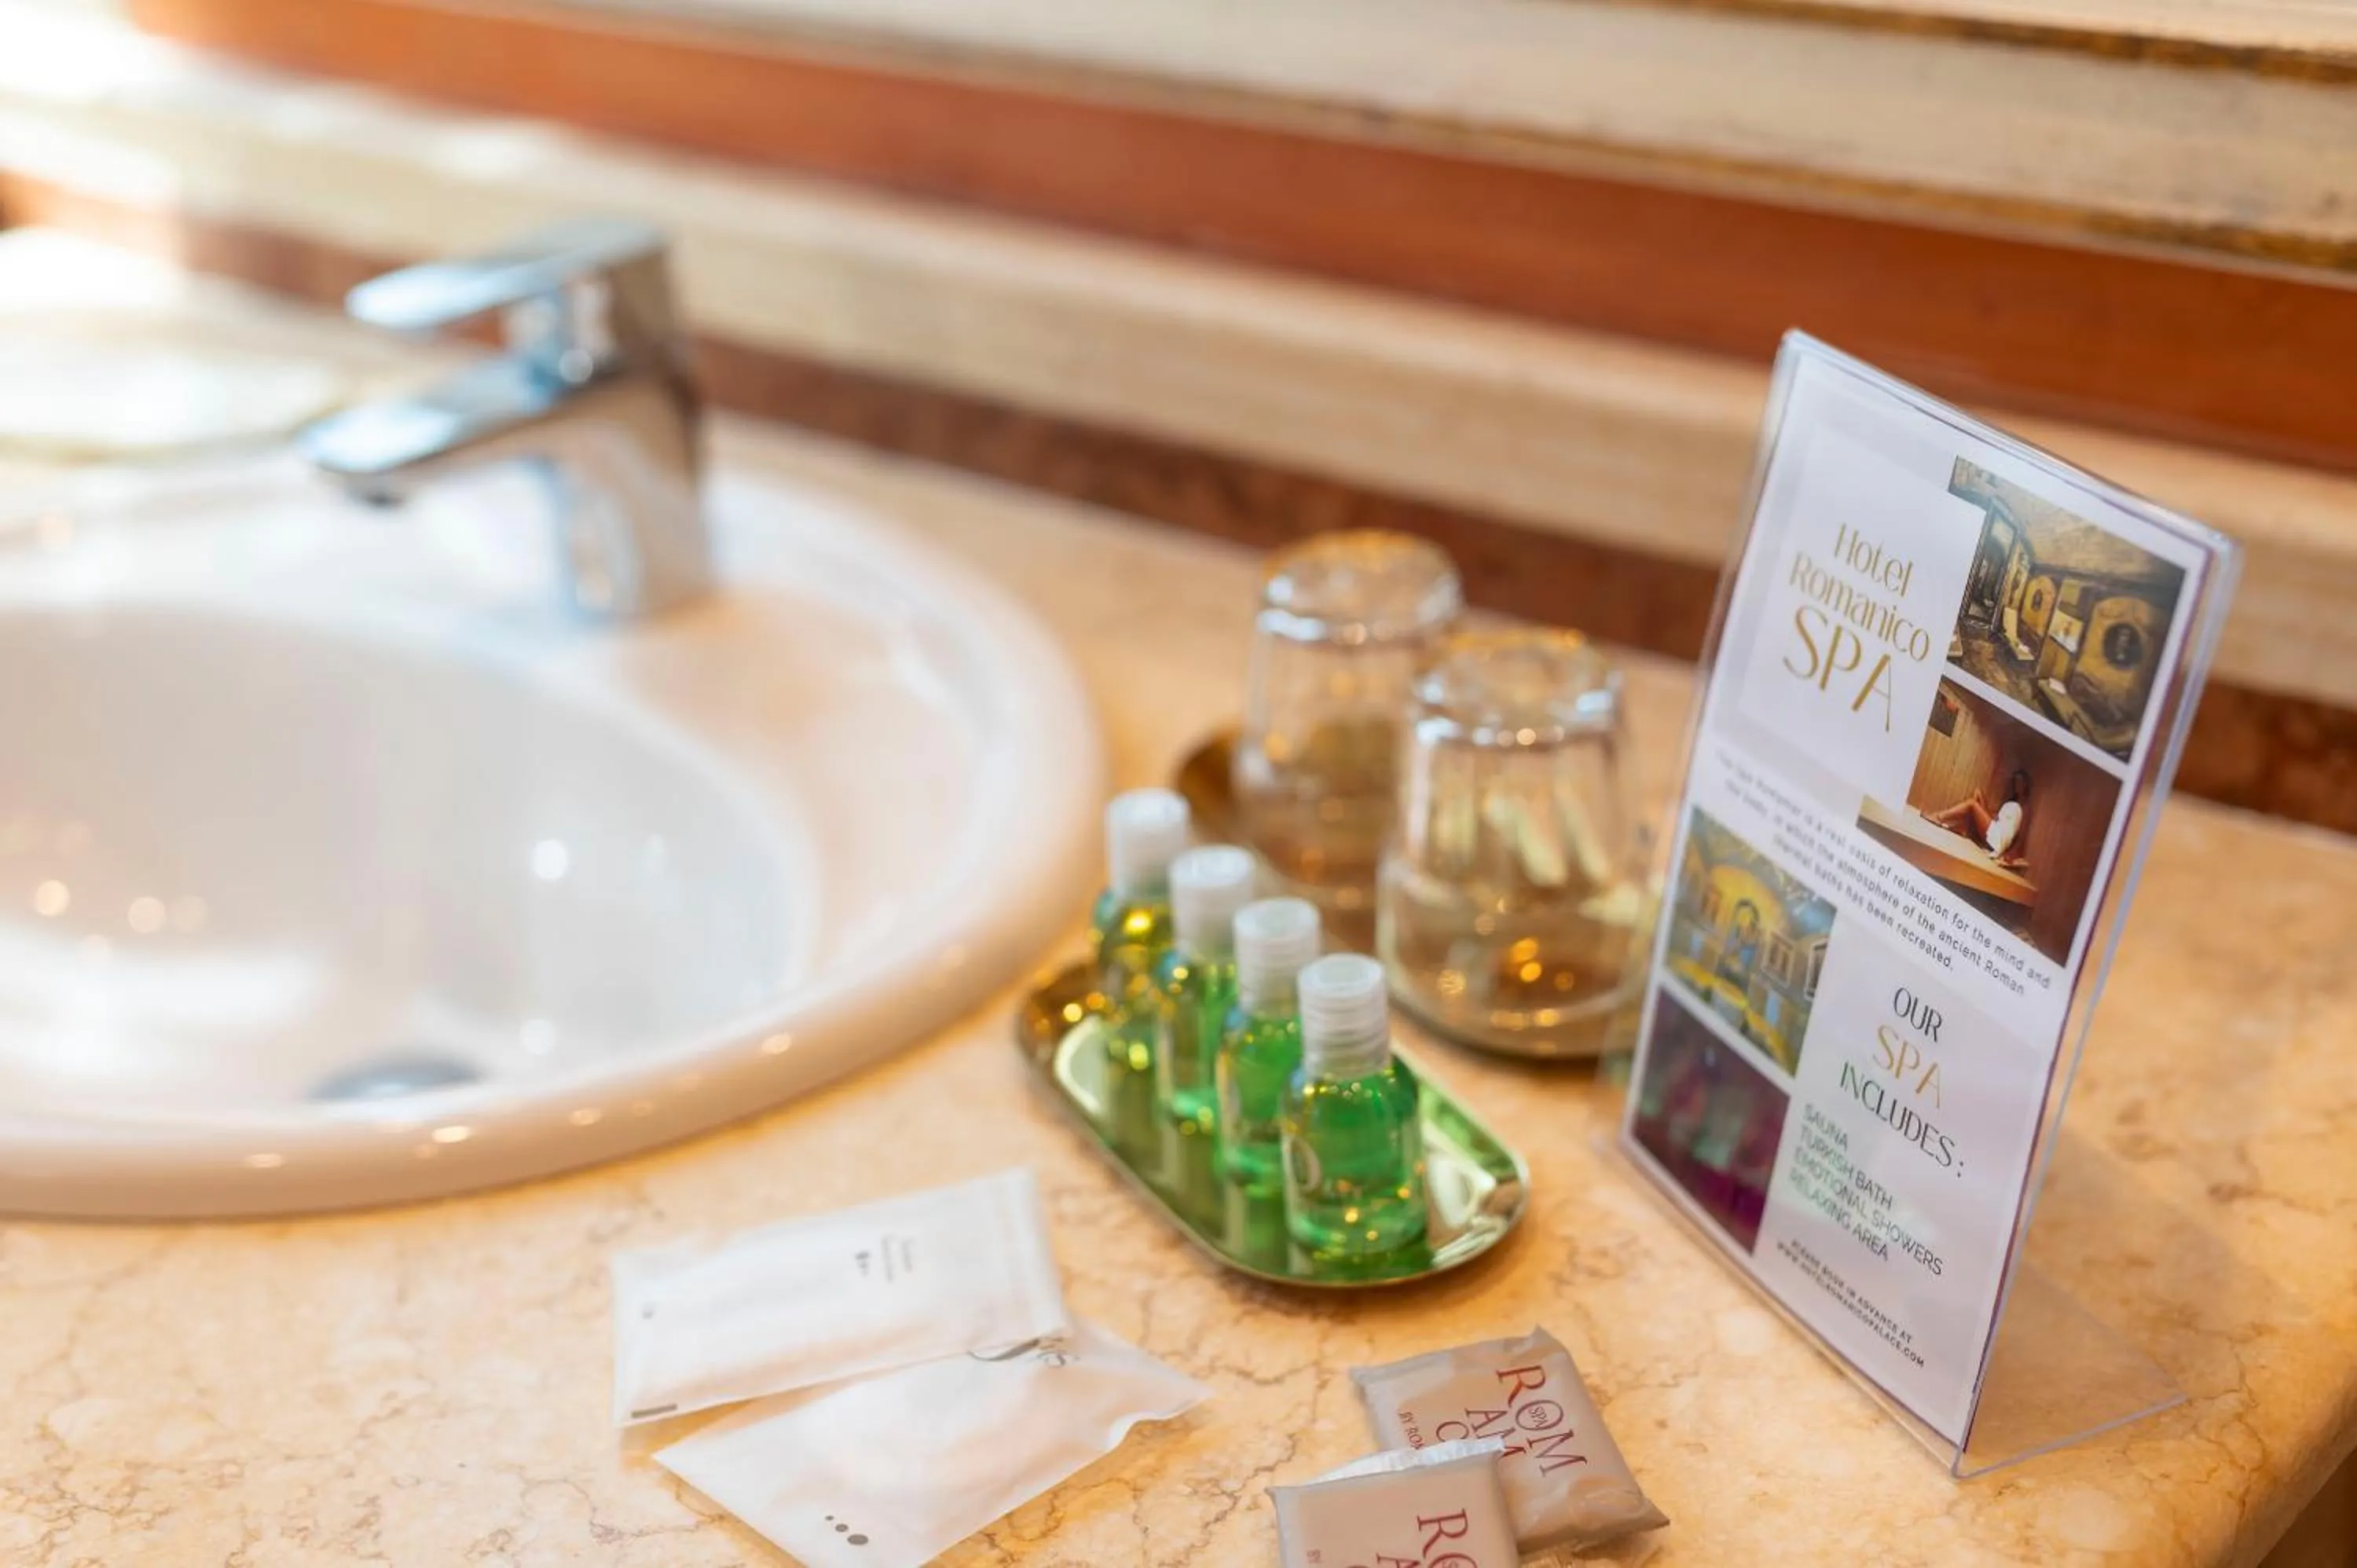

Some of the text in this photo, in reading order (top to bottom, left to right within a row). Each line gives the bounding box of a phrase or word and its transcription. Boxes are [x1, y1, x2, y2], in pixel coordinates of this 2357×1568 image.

[1834, 522, 1913, 598] Hotel
[1789, 551, 1930, 662] Romanico
[1782, 604, 1892, 733] SPA
[1837, 859, 1900, 907] atmosphere
[1902, 903, 1915, 918] of
[1917, 912, 1937, 933] the
[1938, 929, 1981, 966] ancient
[1985, 958, 2025, 995] Roman
[1846, 884, 1865, 906] has
[1868, 899, 1894, 929] been
[1897, 922, 1954, 972] recreated.
[1879, 866, 1892, 879] of
[1893, 874, 1949, 919] relaxation
[1952, 912, 1970, 932] for
[1972, 926, 1992, 949] the
[1994, 943, 2025, 972] mind
[2027, 966, 2052, 990] and
[1893, 987, 1943, 1043] OUR
[1871, 1024, 1941, 1109] SPA
[1800, 1123, 1893, 1211] TURKISH BATH
[1804, 1103, 1848, 1151] SAUNA
[1788, 1166, 1890, 1262] RELAXING AREA
[1794, 1145, 1944, 1276] EMOTIONAL SHOWERS
[1857, 1295, 1898, 1333] ADVANCE
[1899, 1330, 1913, 1344] AT
[1496, 1365, 1588, 1478] ROM
